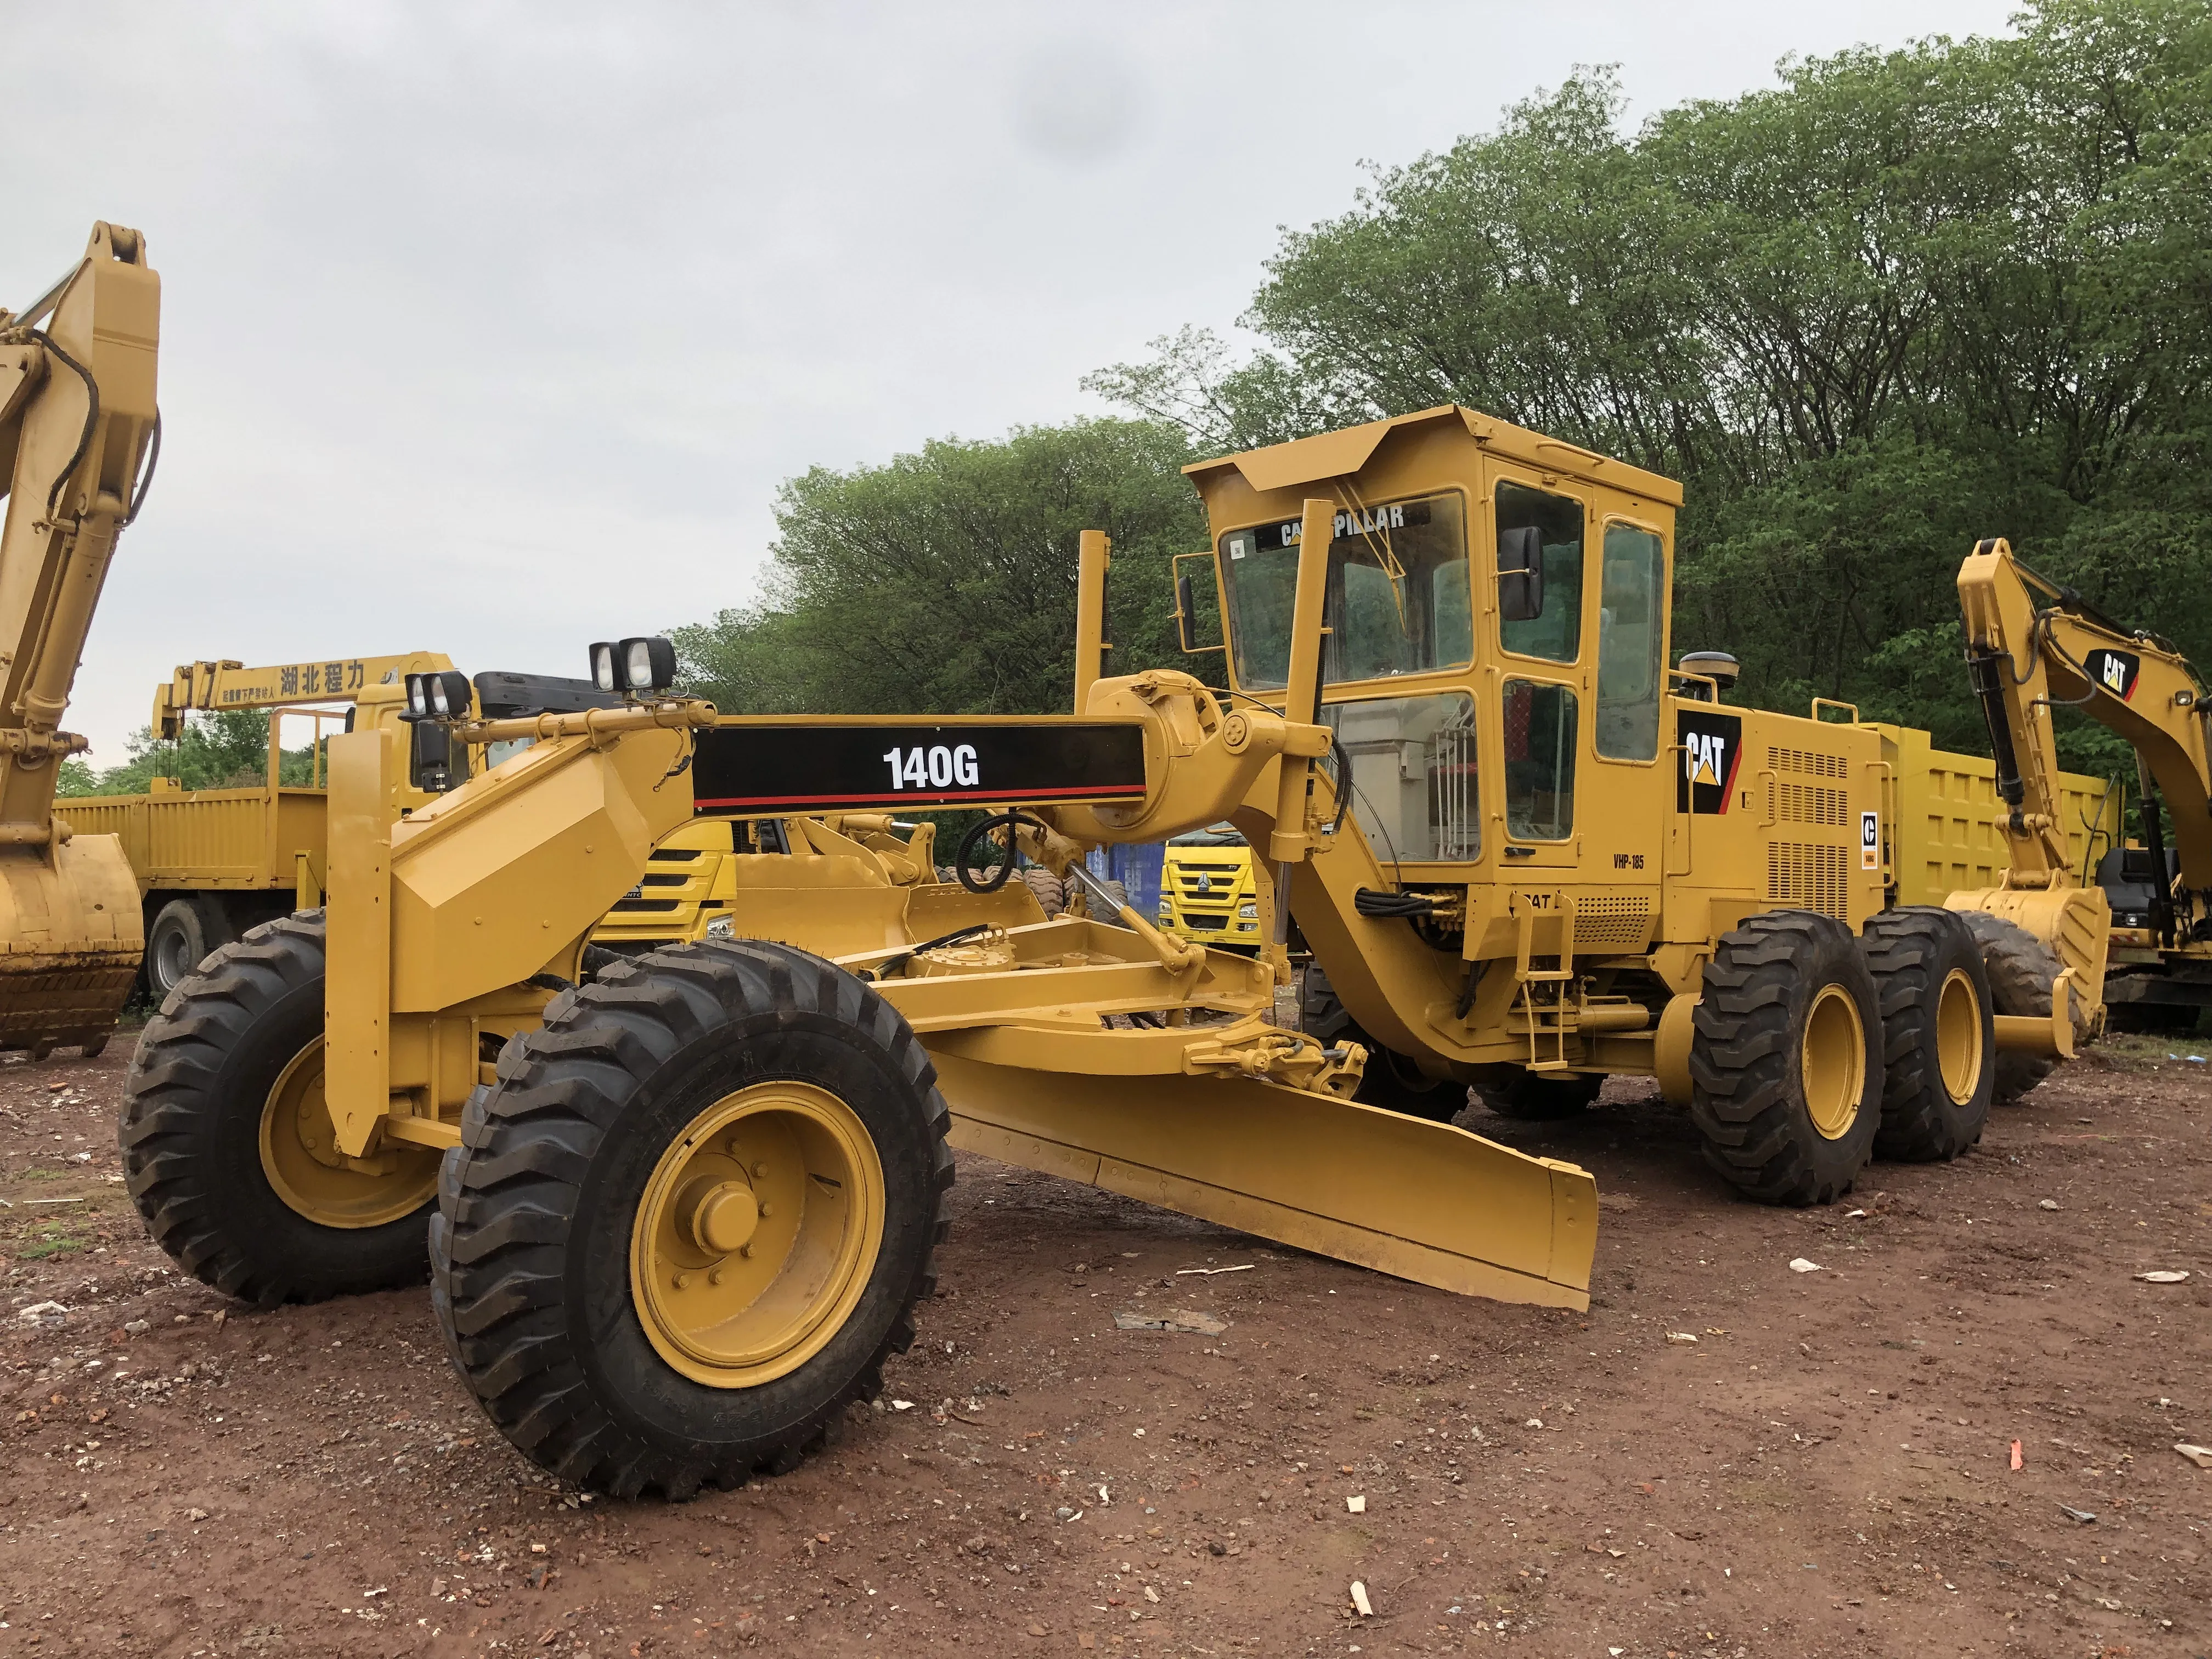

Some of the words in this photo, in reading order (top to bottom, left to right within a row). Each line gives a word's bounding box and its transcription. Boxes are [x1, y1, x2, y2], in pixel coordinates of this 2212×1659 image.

[1282, 506, 1404, 546] CAPILLAR
[281, 659, 363, 696] 湖北程力
[2103, 653, 2125, 693] CAT
[883, 744, 979, 789] 140G
[1686, 732, 1724, 786] CAT
[1613, 854, 1644, 869] VHP-185
